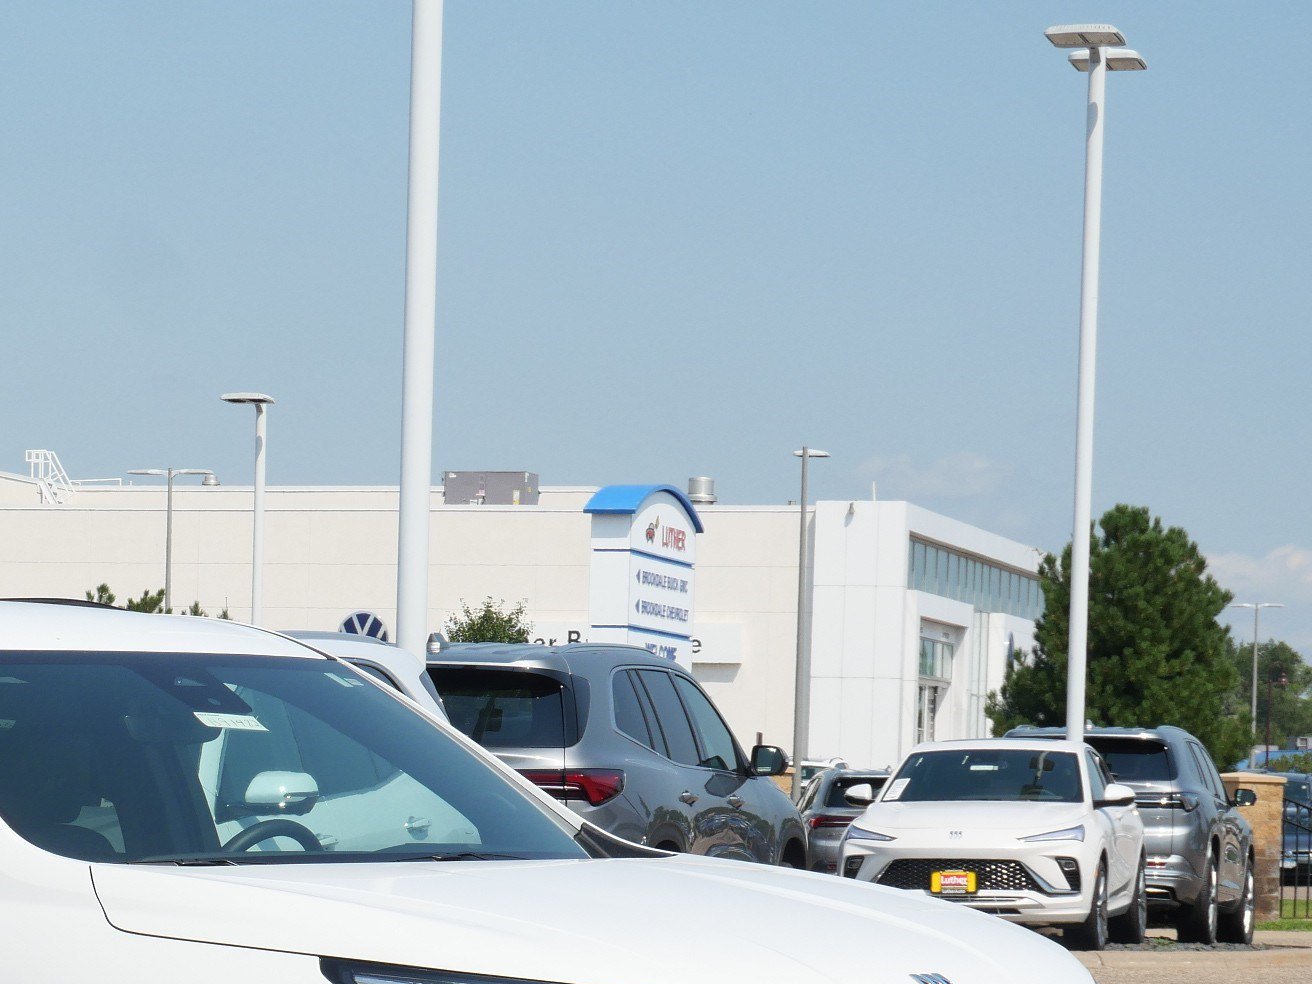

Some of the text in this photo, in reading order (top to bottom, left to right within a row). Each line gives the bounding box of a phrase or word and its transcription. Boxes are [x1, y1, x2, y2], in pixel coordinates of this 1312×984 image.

[662, 525, 686, 551] LUTHER
[642, 570, 667, 588] BROOKDALE
[641, 600, 689, 621] BROOKDALE CHEVROLET
[941, 876, 967, 885] Luther
